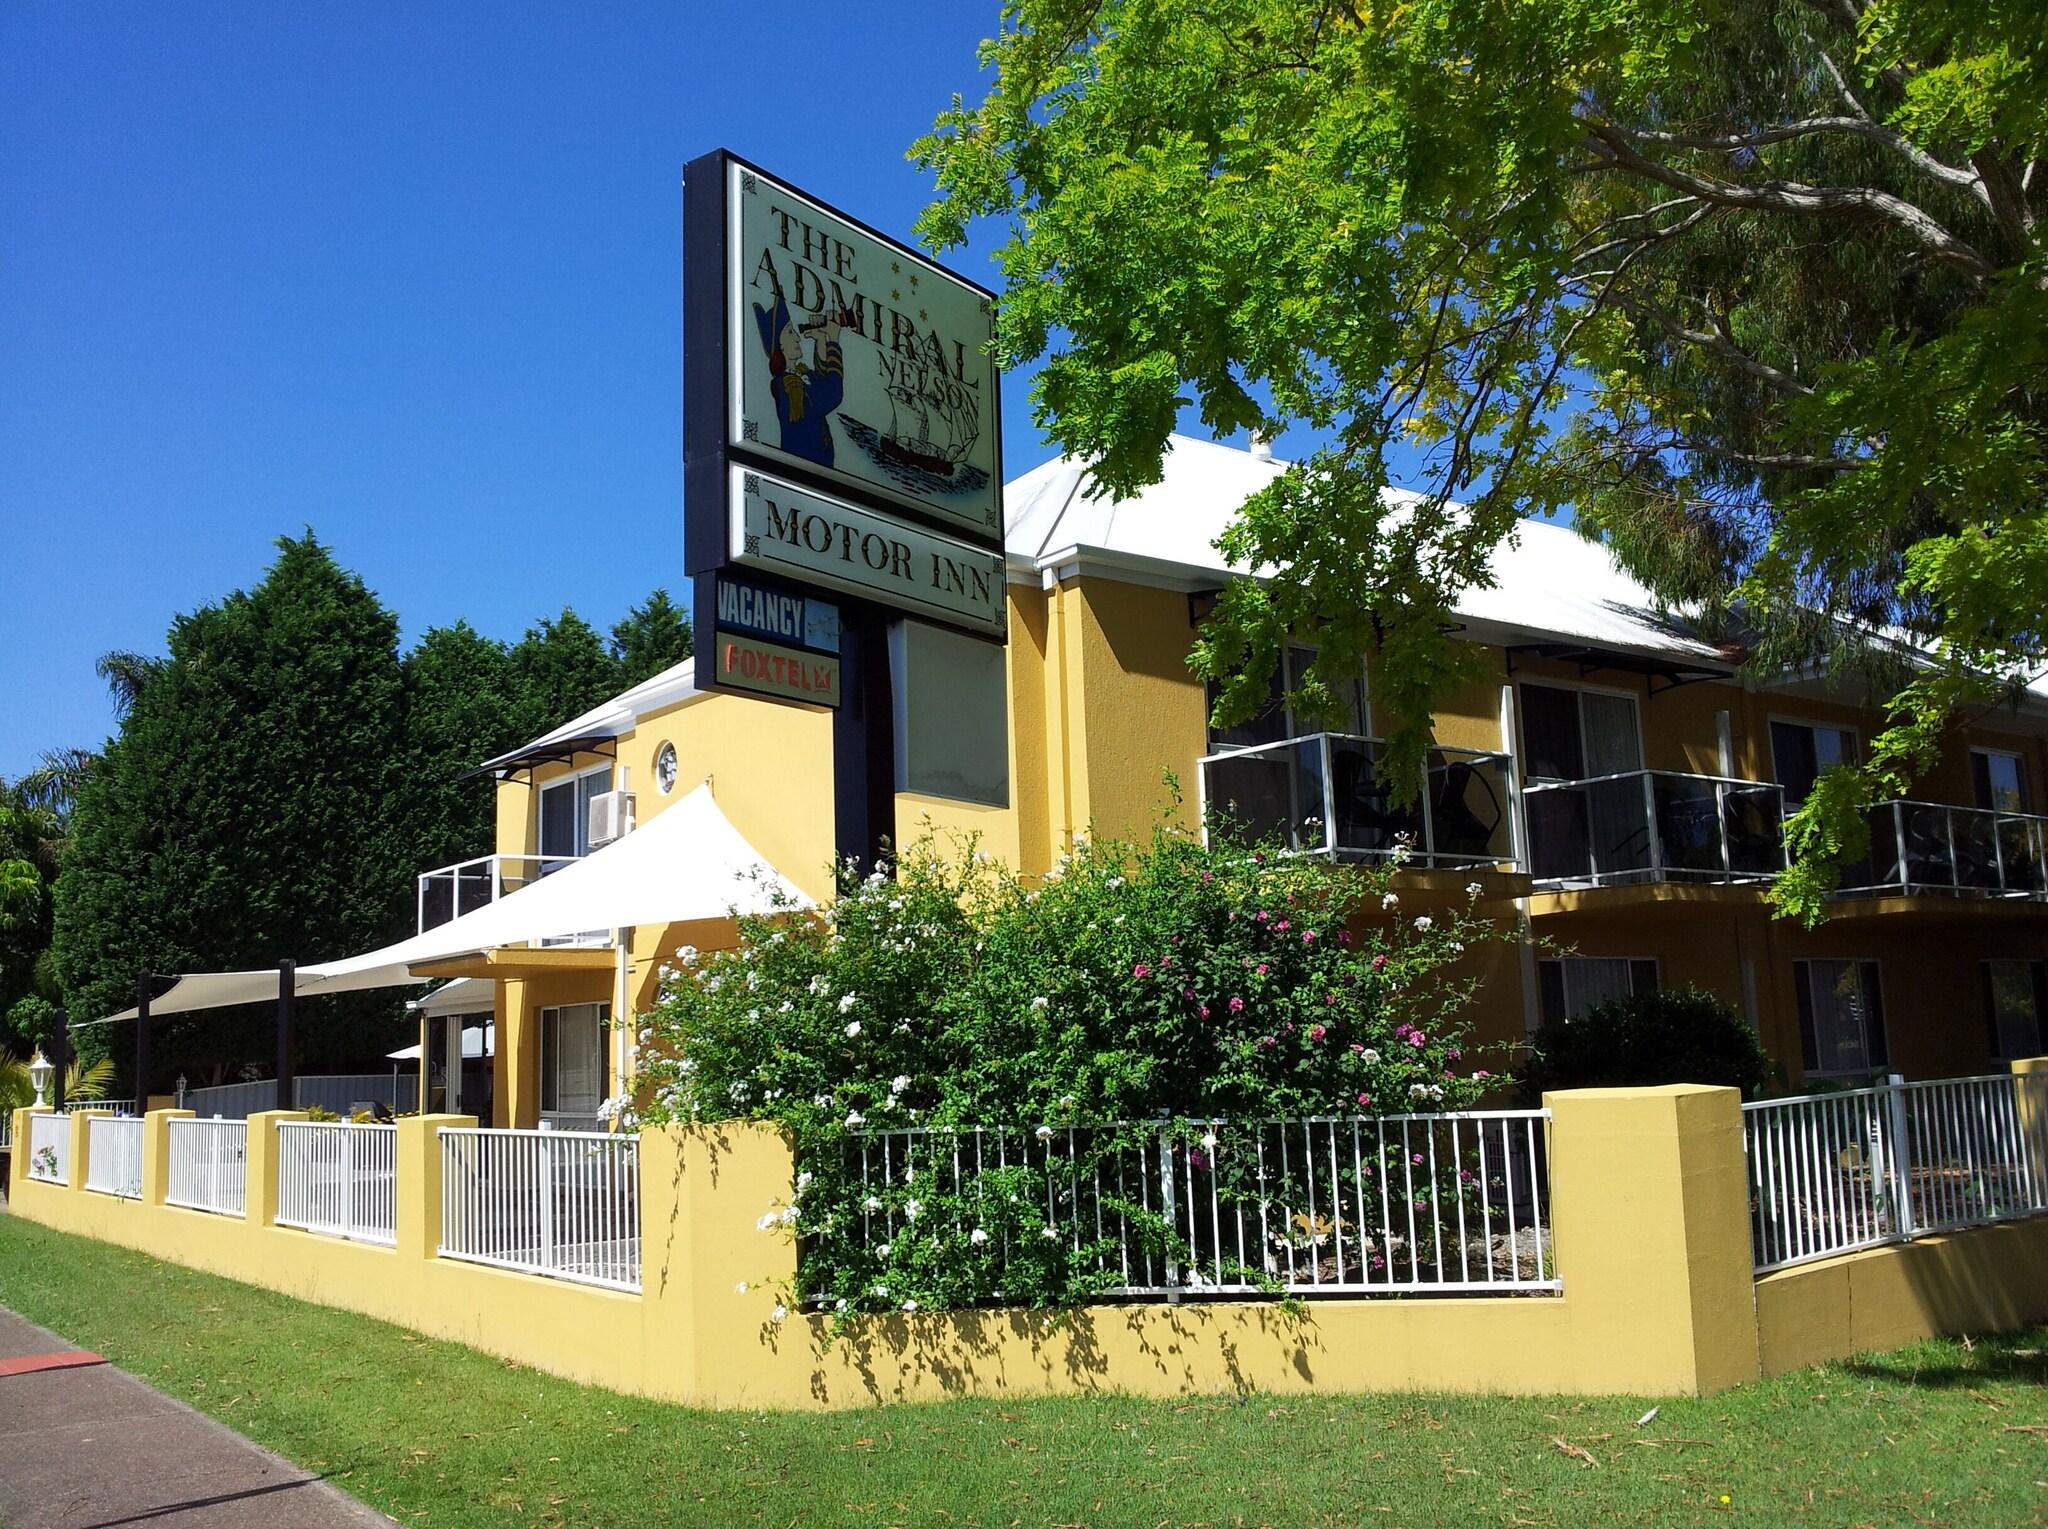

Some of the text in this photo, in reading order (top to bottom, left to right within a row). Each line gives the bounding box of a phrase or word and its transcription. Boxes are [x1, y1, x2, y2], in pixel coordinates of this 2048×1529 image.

[771, 206, 857, 284] THE
[750, 247, 979, 390] ADMIRAL
[764, 499, 991, 604] MOTOR INN
[718, 580, 802, 638] VACANCY
[725, 643, 811, 691] FOXTEL
